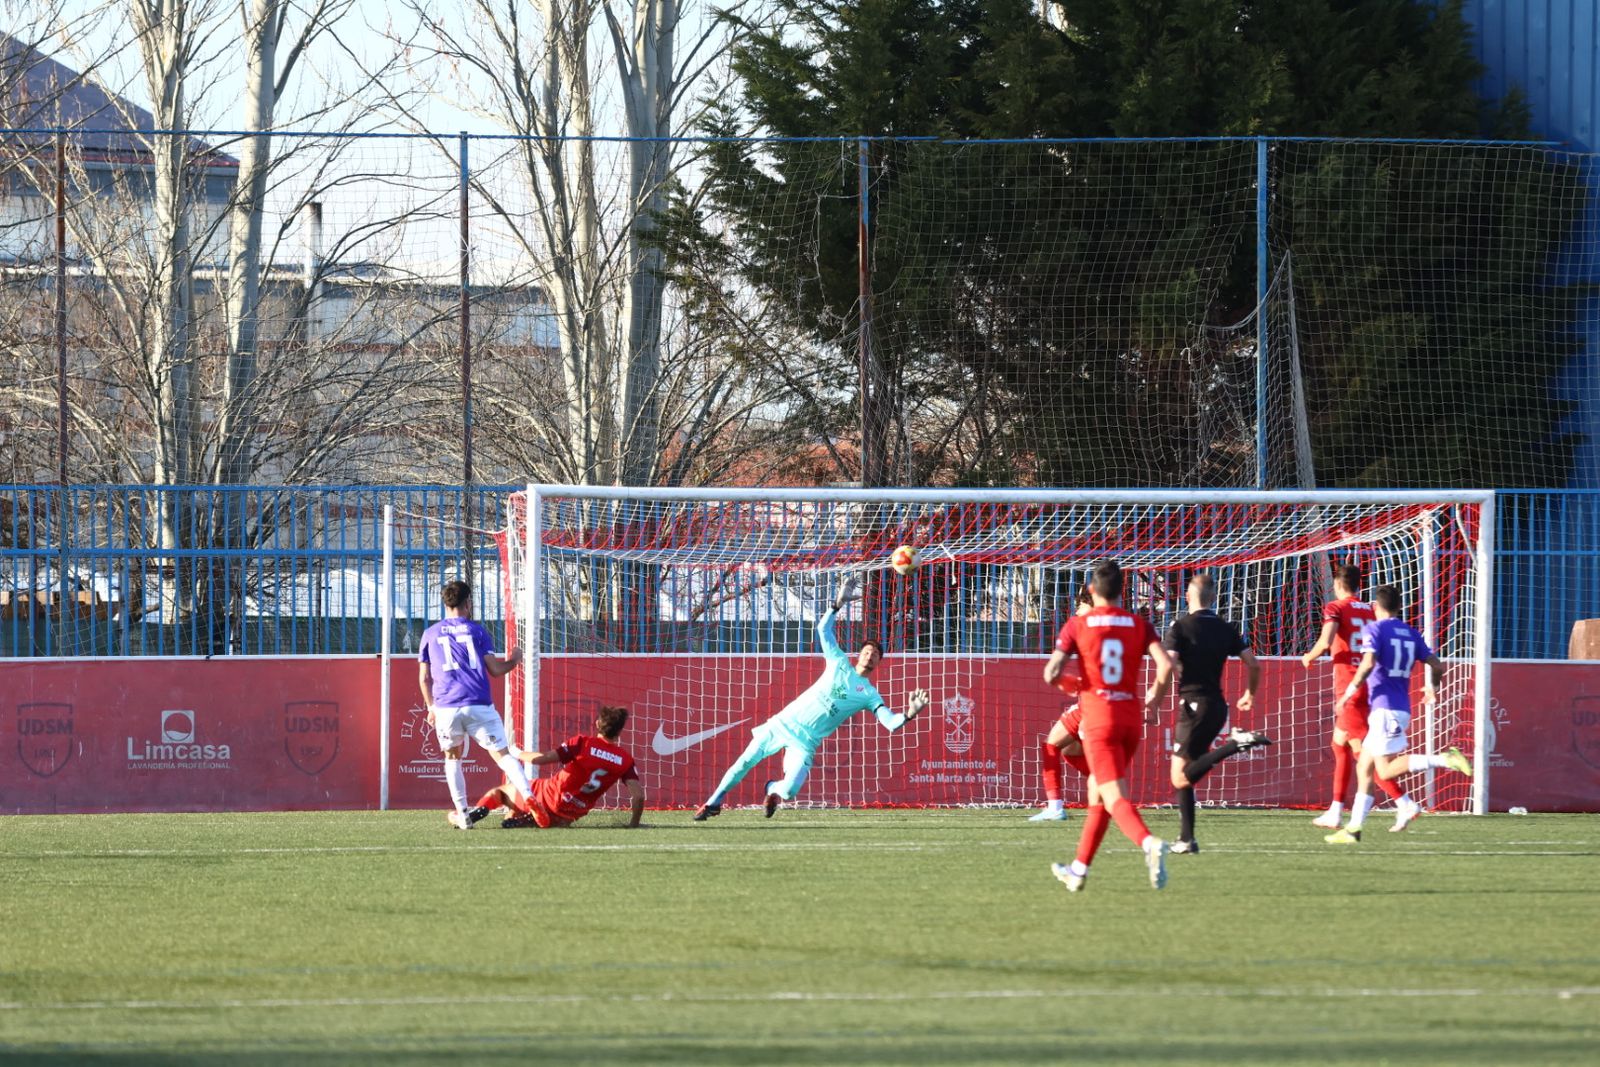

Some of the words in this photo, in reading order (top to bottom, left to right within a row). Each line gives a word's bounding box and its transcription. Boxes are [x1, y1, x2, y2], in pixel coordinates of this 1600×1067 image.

[1100, 638, 1124, 685] 8
[17, 719, 73, 736] UDSM
[283, 717, 339, 734] UDSM
[127, 737, 230, 760] Limcasa
[398, 764, 440, 774] Matadero
[921, 759, 984, 770] Ayuntamiento
[985, 759, 997, 769] de
[580, 768, 608, 793] 5
[909, 773, 935, 783] Santa
[936, 773, 963, 783] Marta
[964, 773, 976, 783] de
[977, 773, 1009, 783] Tormes
